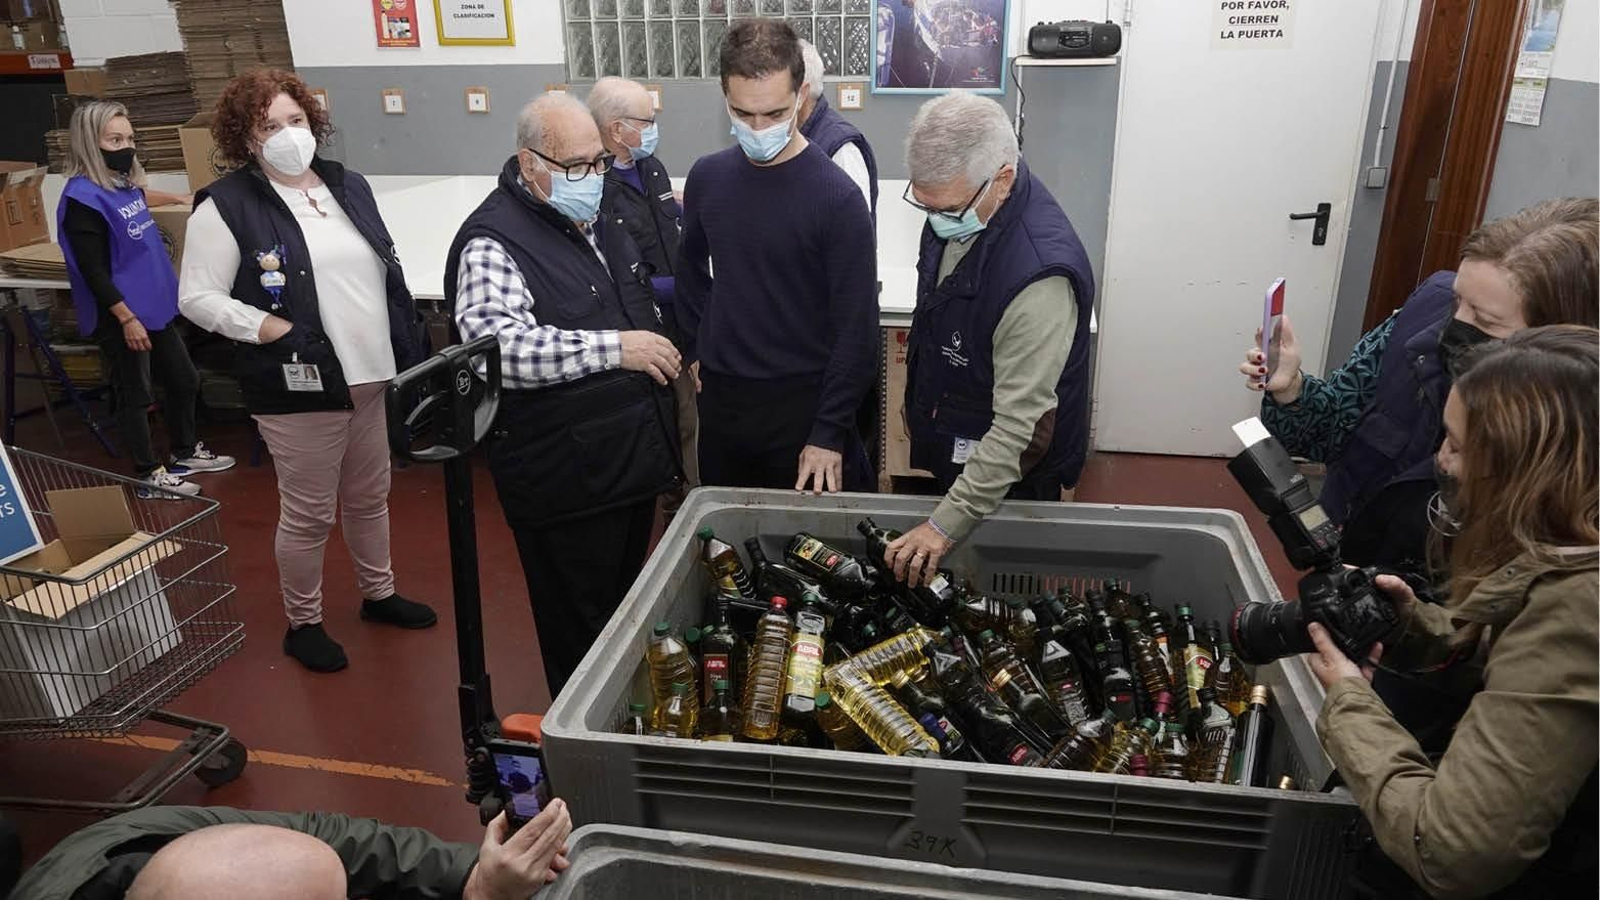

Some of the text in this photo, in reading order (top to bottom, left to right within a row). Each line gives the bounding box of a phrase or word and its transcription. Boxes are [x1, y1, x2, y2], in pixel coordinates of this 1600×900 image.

[1221, 0, 1290, 10] POR FAVOR,
[1228, 15, 1279, 24] CIERREN
[1220, 29, 1284, 39] LA PUERTA
